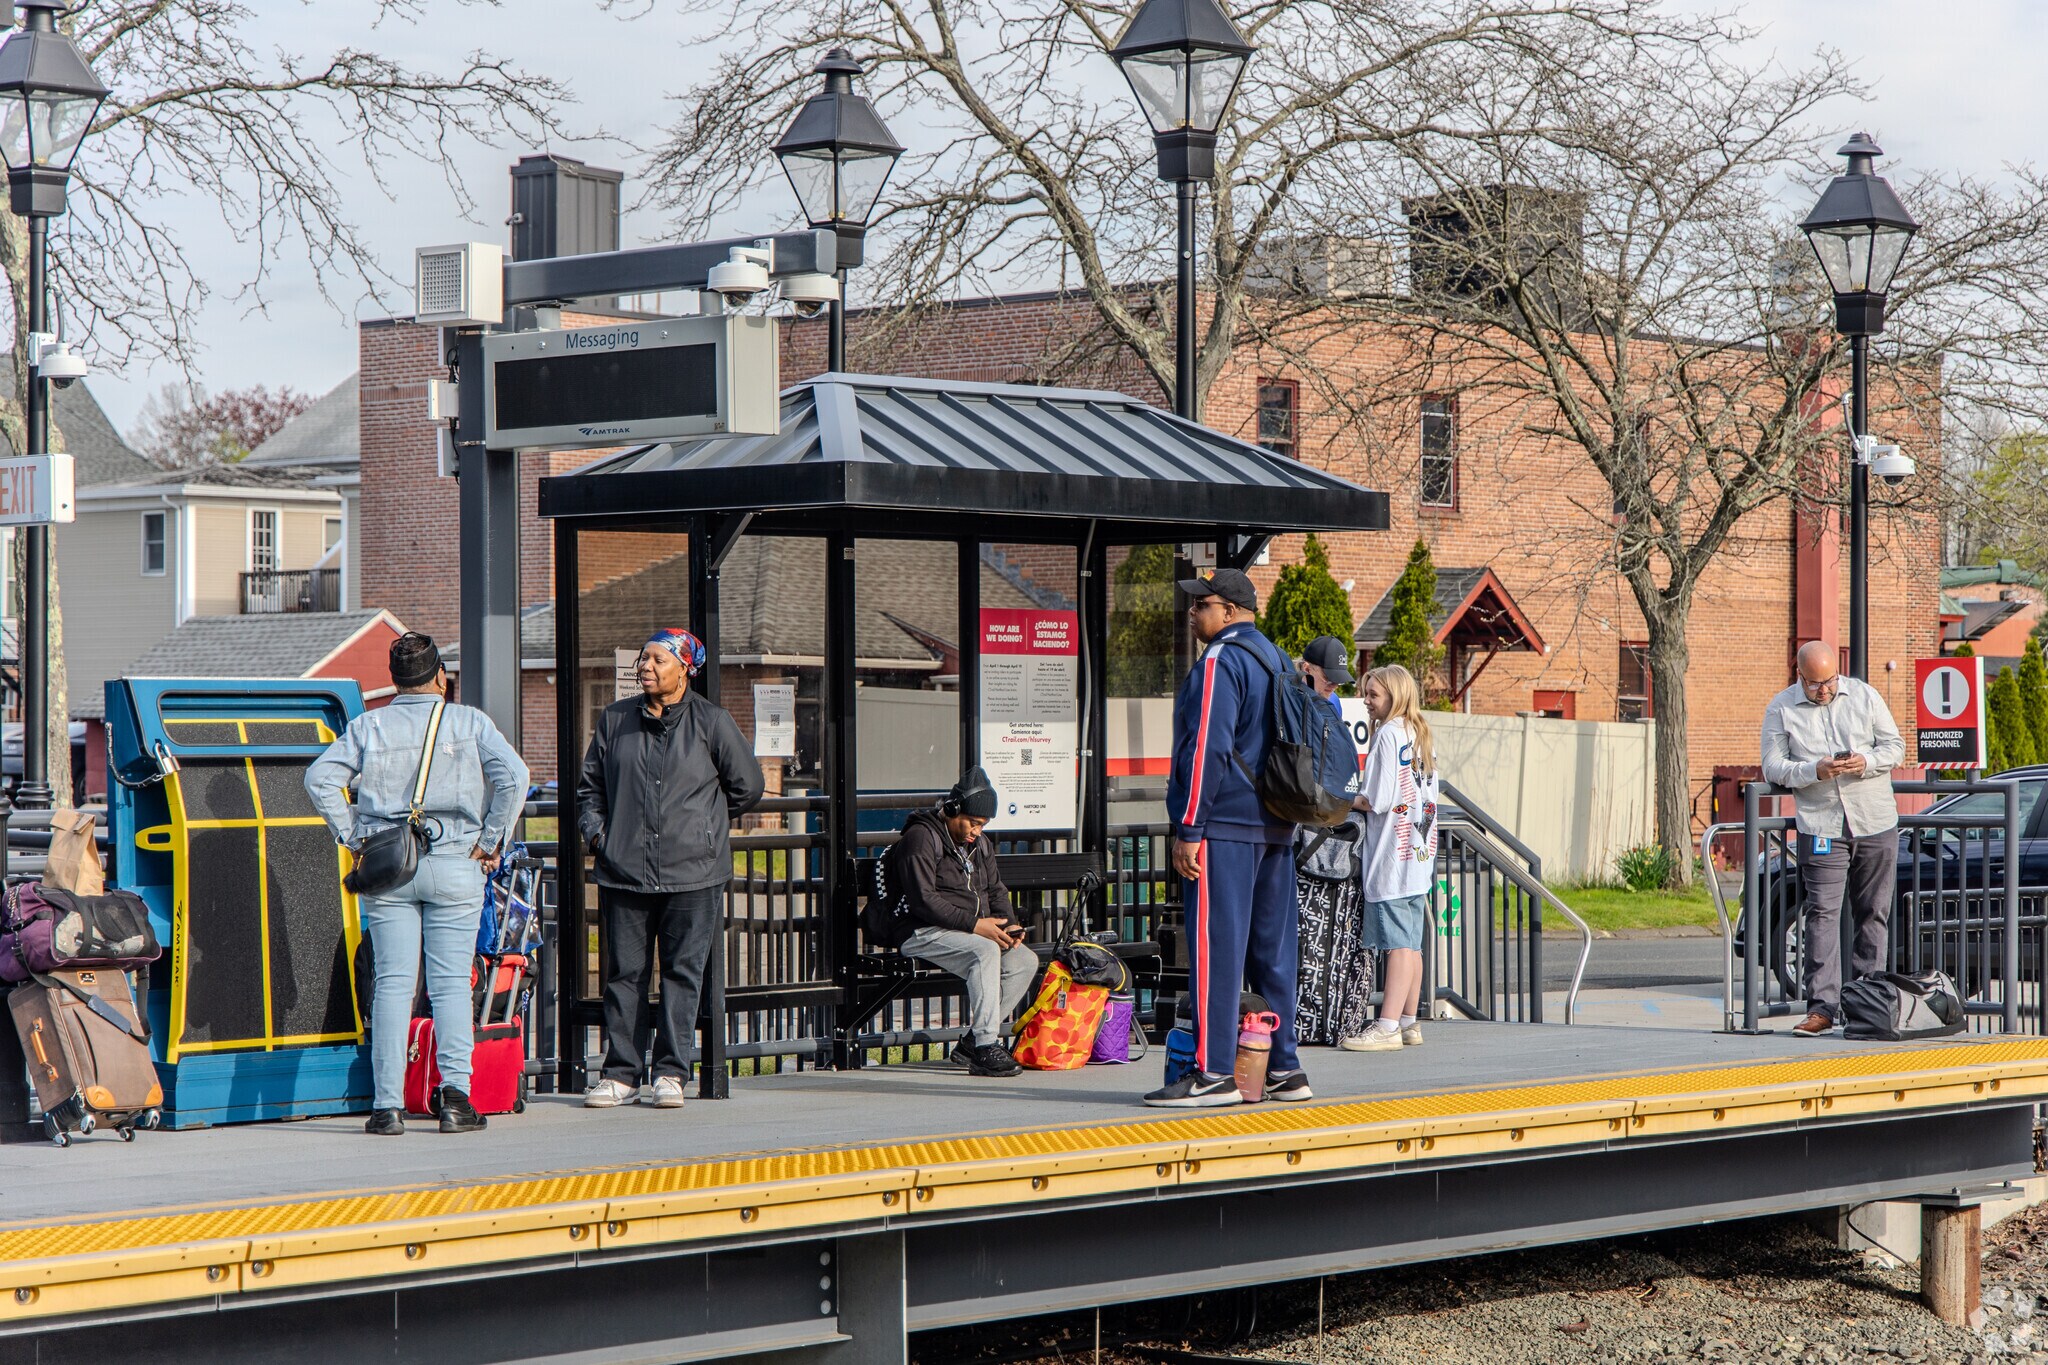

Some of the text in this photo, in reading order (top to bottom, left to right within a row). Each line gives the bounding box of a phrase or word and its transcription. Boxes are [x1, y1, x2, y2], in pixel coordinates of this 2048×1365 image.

[565, 328, 640, 350] Messaging
[592, 427, 631, 436] AMTRAK
[0, 465, 37, 515] EXIT
[989, 624, 1020, 633] HOW ARE
[1034, 620, 1069, 631] ¿CÓMO LO
[986, 634, 1023, 643] WE DOING?
[1036, 631, 1067, 639] ESTAMOS
[1033, 640, 1070, 648] HACIENDO?
[1921, 731, 1964, 739] AUTHORIZED
[1921, 740, 1961, 748] PERSONNEL
